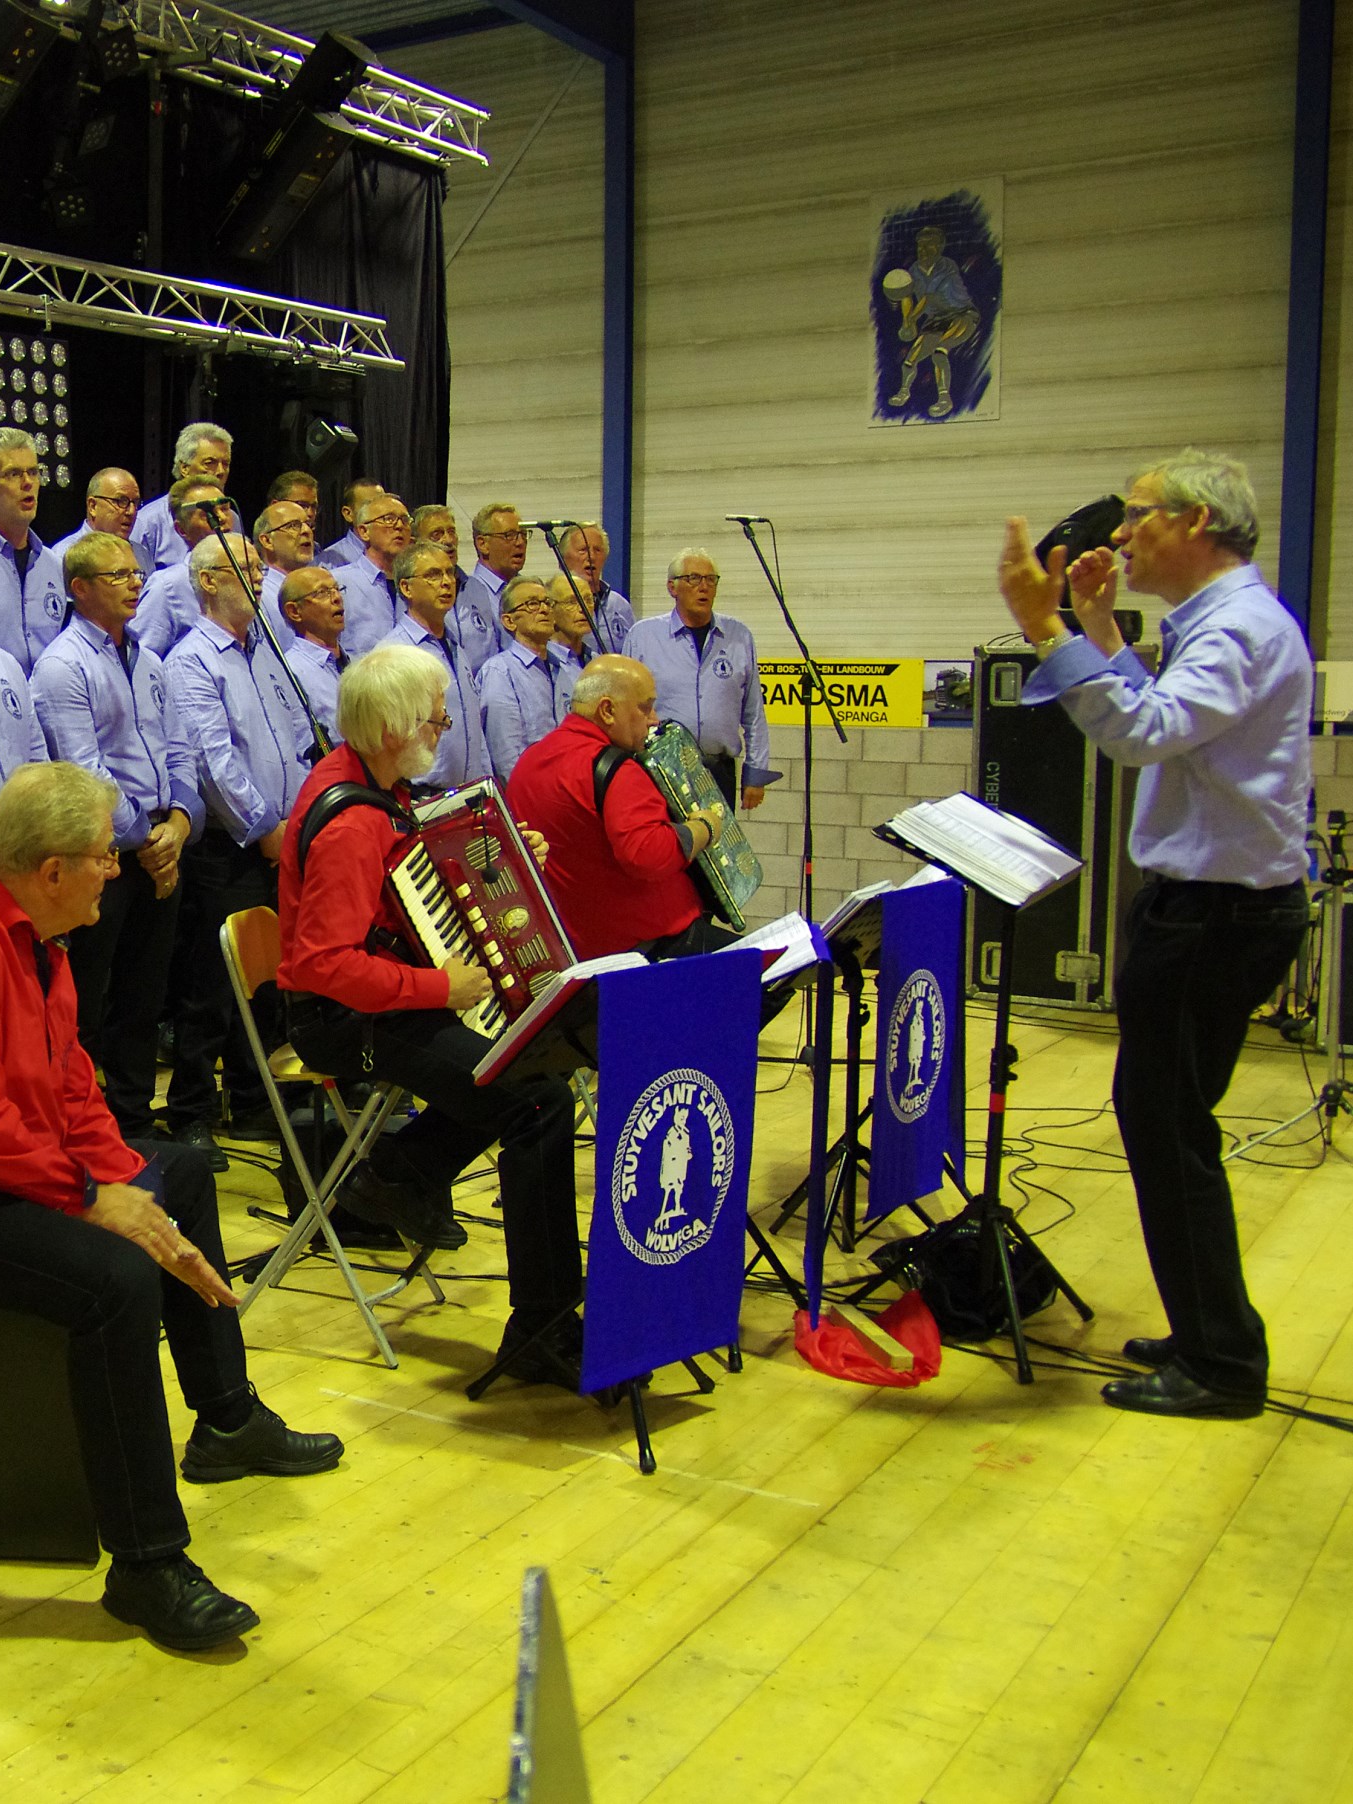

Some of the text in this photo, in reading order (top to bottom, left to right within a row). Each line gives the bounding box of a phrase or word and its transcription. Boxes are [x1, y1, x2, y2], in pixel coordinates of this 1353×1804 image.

[836, 665, 886, 674] LANDBOUW
[837, 710, 888, 722] SPANGA
[889, 980, 942, 1073] STUYVESANT SAILORS
[621, 1083, 726, 1203] STUYVESANT SAILORS
[645, 1218, 708, 1252] WOLVEGA
